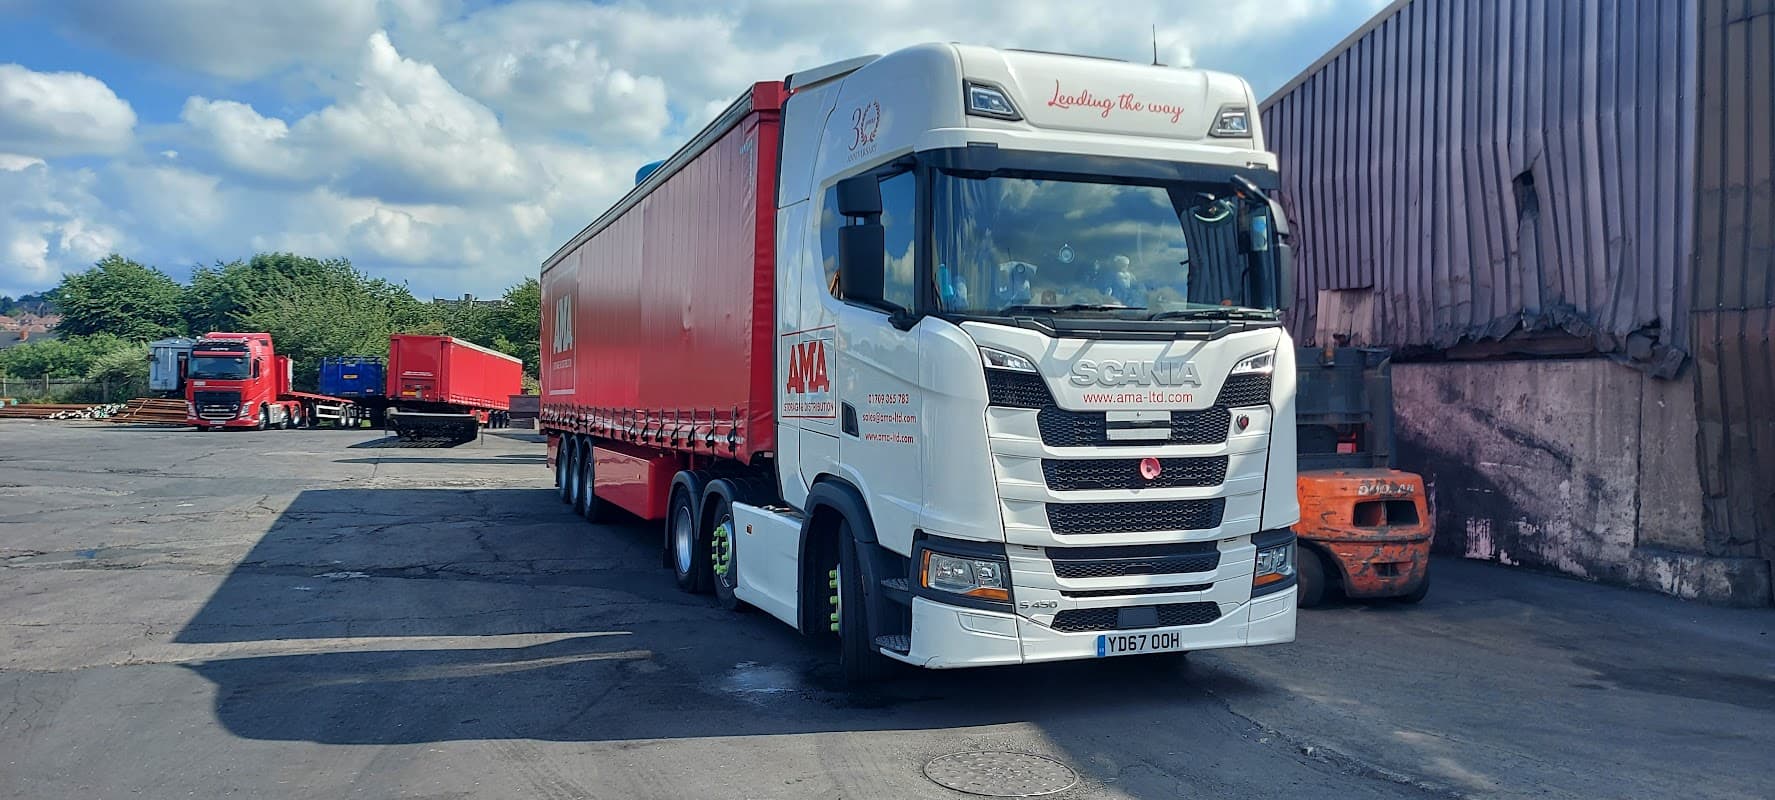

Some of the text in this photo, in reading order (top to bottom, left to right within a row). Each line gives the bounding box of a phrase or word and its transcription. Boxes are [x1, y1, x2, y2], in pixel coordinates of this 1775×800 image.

[1048, 79, 1185, 124] Leading the way
[553, 293, 572, 354] AMA
[786, 339, 830, 394] AMA
[1069, 359, 1202, 388] SCANIA
[1083, 391, 1193, 403] www.ama-ltd.com
[784, 402, 800, 412] STORAG
[805, 401, 834, 412] DISTRIBUTION
[862, 411, 917, 423] sales@ama-ltd.com
[864, 432, 914, 444] www.ama-ltd.com
[1019, 600, 1058, 609] S 450
[1108, 635, 1147, 653] YD67
